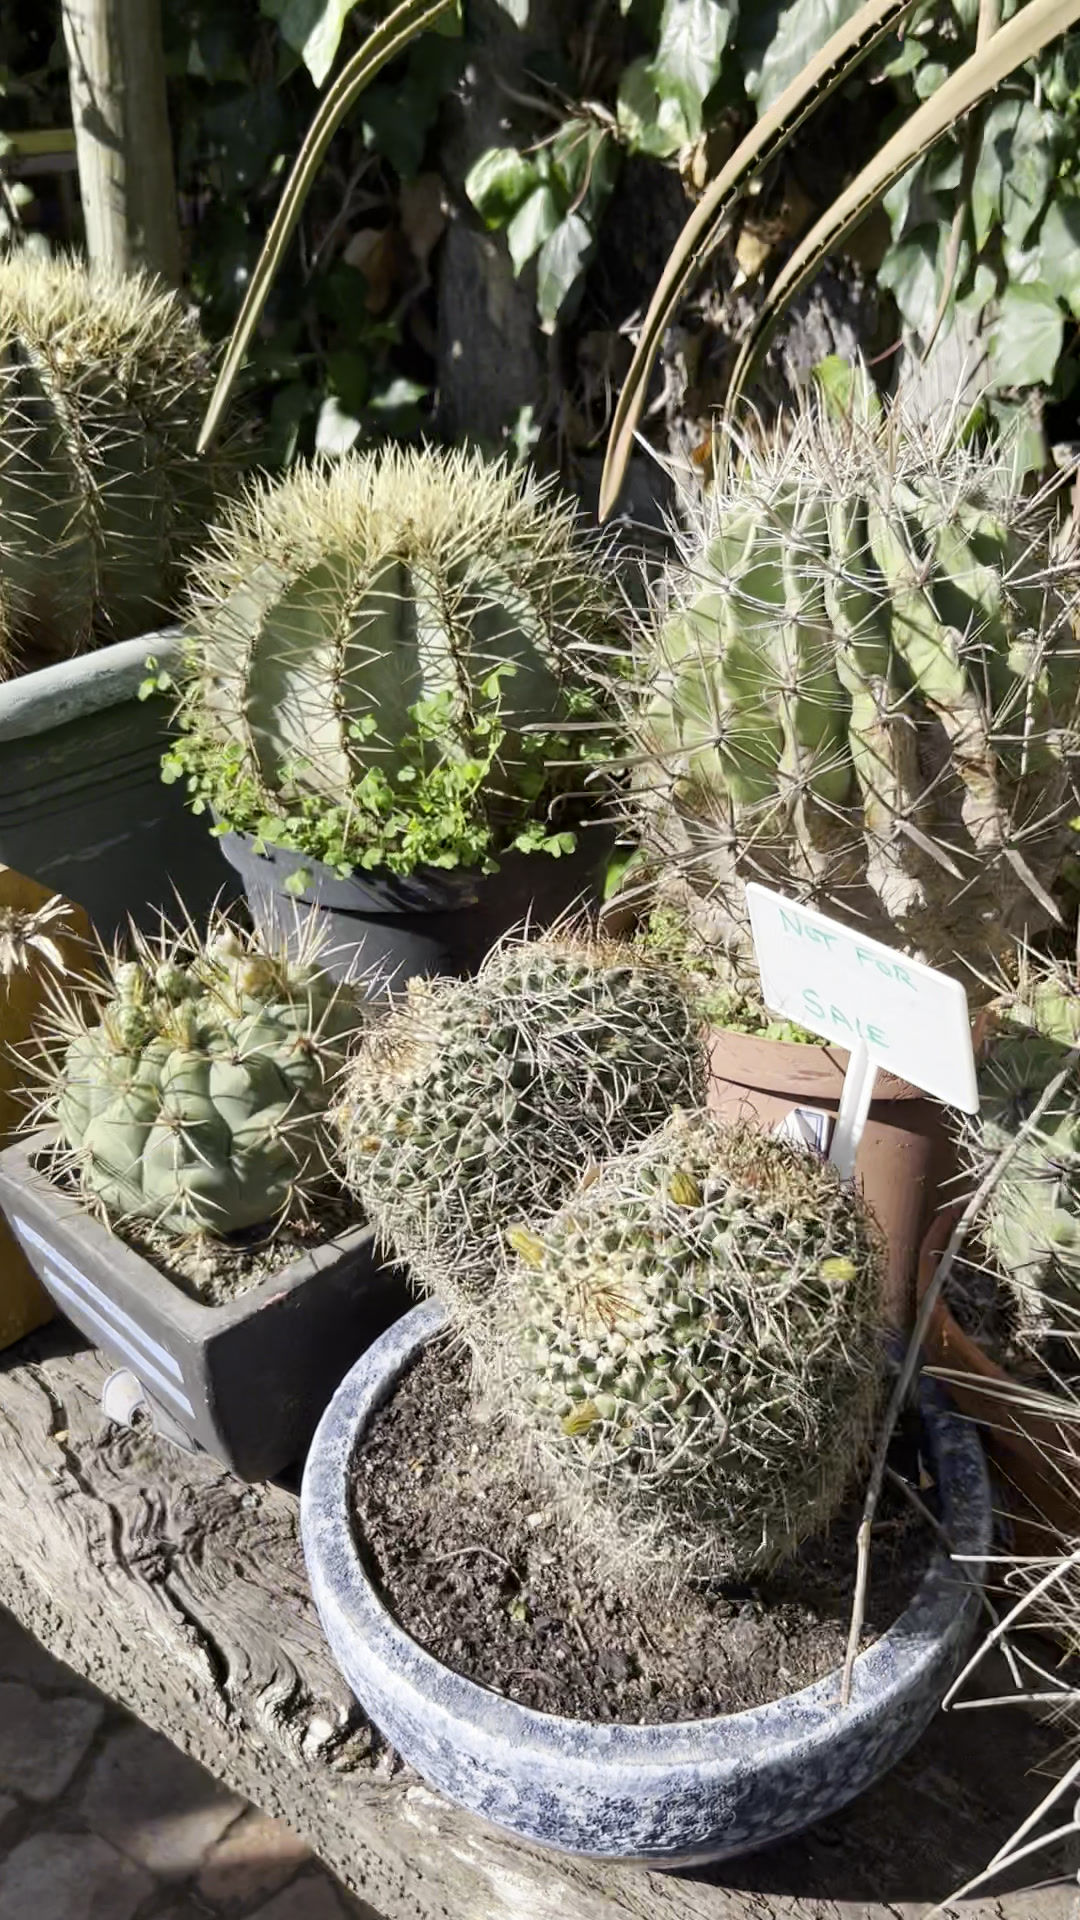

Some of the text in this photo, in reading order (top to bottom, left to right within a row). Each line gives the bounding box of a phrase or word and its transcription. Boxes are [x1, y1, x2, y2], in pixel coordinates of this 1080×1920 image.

[779, 908, 918, 992] NOT FOR
[802, 988, 890, 1048] SALE
